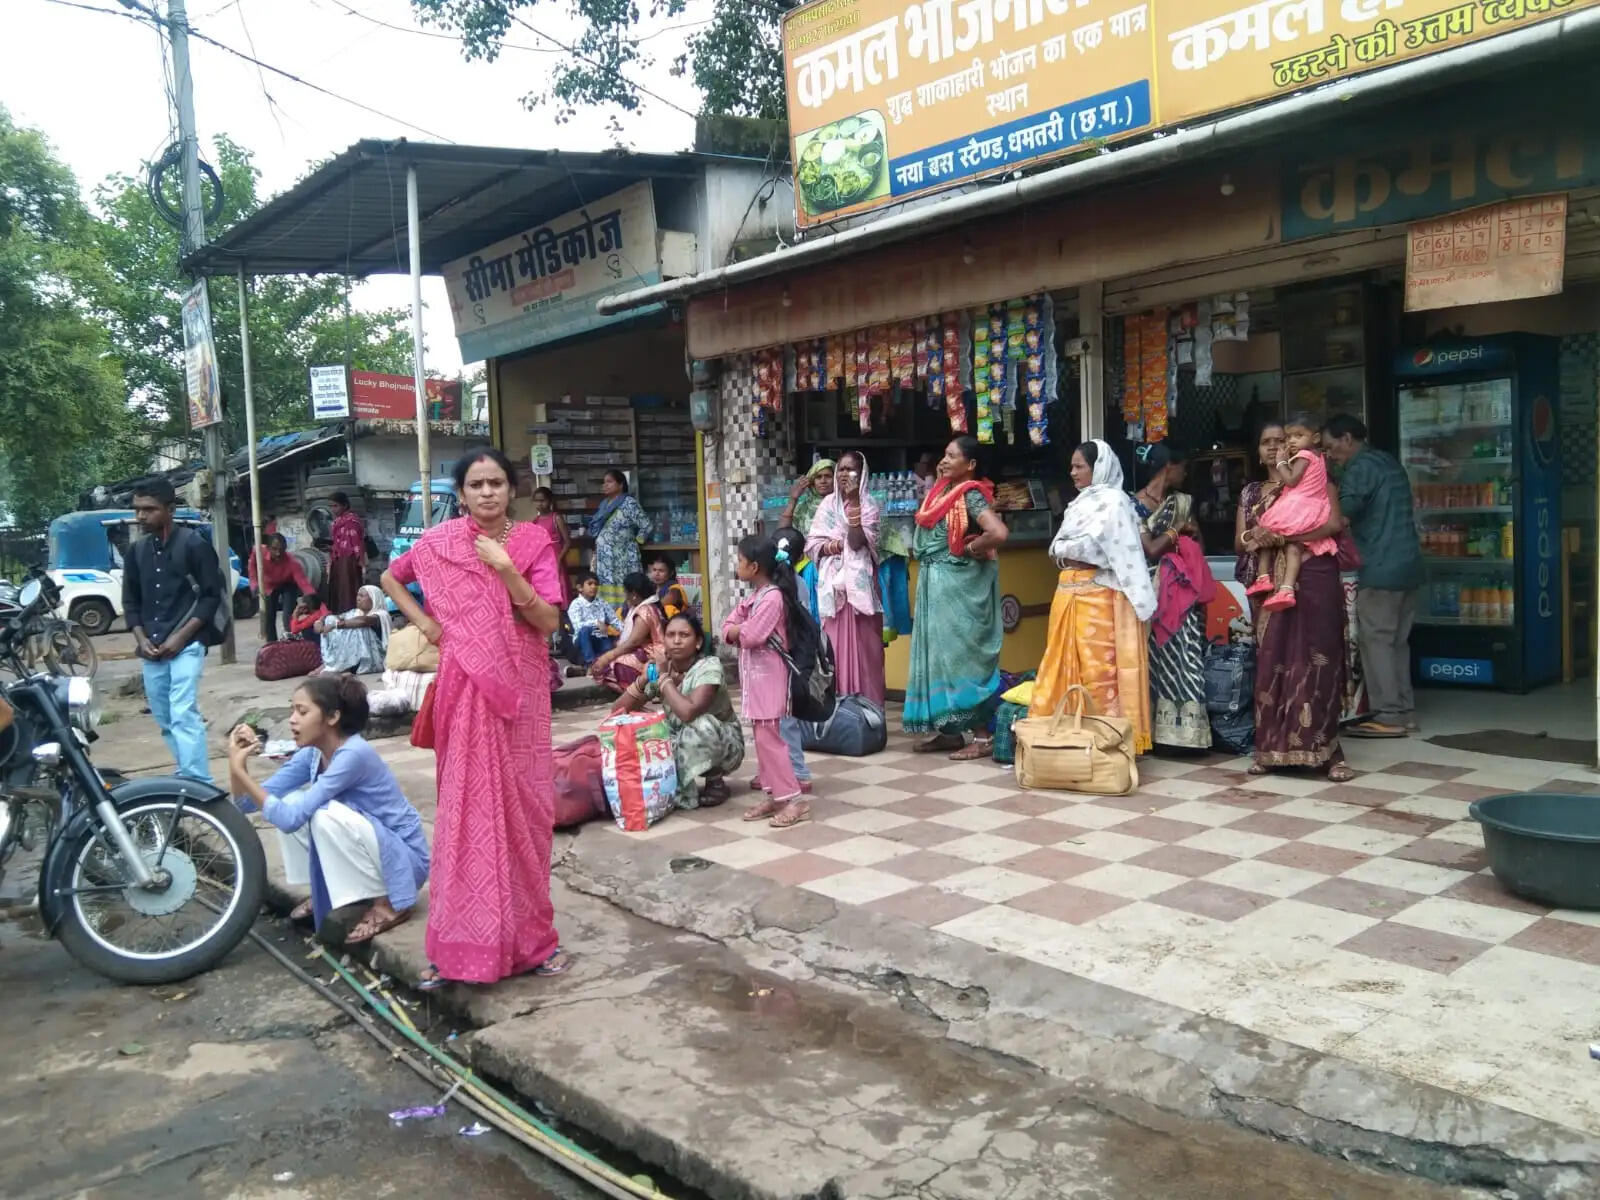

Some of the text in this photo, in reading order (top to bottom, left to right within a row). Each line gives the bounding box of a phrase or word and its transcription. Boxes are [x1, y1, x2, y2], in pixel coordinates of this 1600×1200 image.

[793, 15, 899, 108] कमल
[886, 3, 1148, 124] शुद्ध शाकाहारी भोजन का एक मात्र
[1272, 34, 1349, 88] ठहरने
[1353, 18, 1398, 61] की
[1403, 0, 1478, 49] उत्तम
[986, 83, 1029, 117] स्थान
[896, 162, 924, 189] नया
[928, 150, 954, 177] बस
[462, 255, 515, 302] सीमा
[515, 208, 623, 280] मेडिकोज
[353, 377, 378, 389] Lucky
[1437, 345, 1485, 365] pepsi
[1536, 496, 1553, 620] pepsi
[1430, 661, 1480, 680] pepsi
